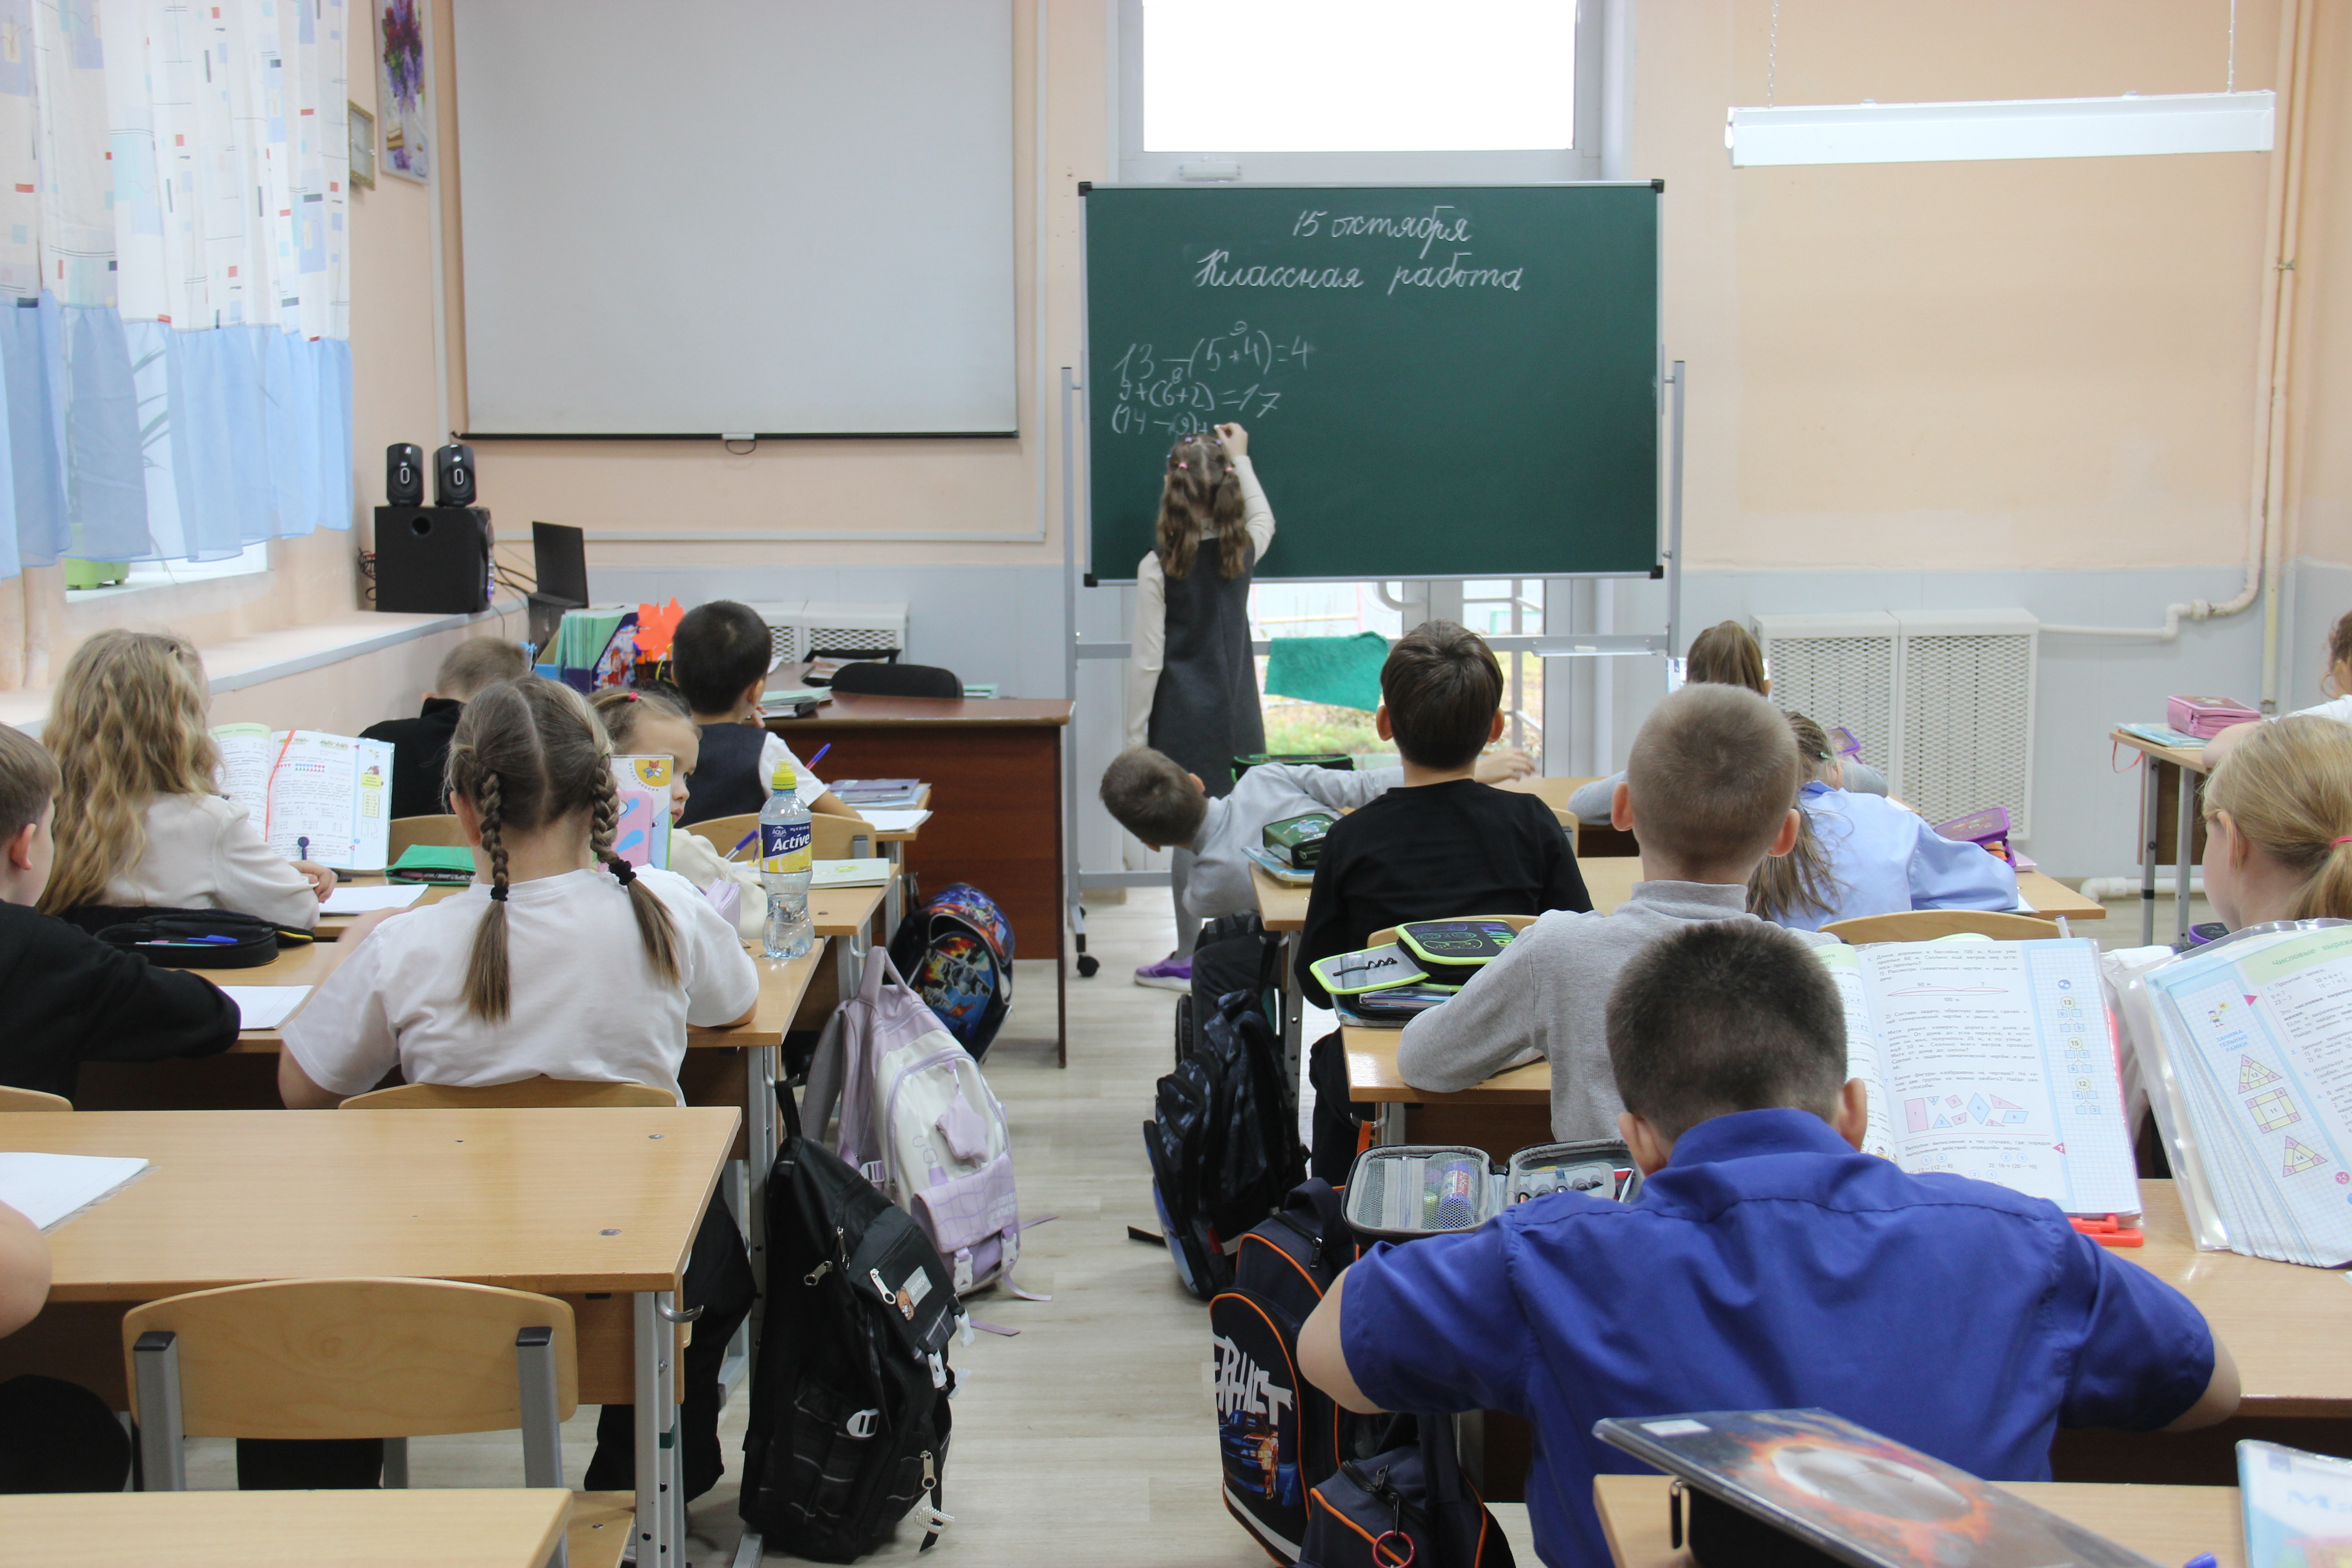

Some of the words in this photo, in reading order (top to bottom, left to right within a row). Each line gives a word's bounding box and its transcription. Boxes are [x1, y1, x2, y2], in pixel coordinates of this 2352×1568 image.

[1294, 211, 1327, 236] 15
[1331, 206, 1472, 259] октября
[1193, 249, 1364, 288] Классная
[1388, 253, 1523, 295] работа
[638, 782, 660, 791] РОССИИ
[2272, 949, 2316, 965] Числовые
[2275, 975, 2301, 988] Прочитай
[2294, 997, 2323, 1009] числовые
[2219, 1034, 2248, 1048] ТЕЛЬНЫЕ
[2293, 1030, 2311, 1039] Найди
[2225, 1042, 2248, 1052] РАМКИ
[2313, 1060, 2343, 1073] Используя
